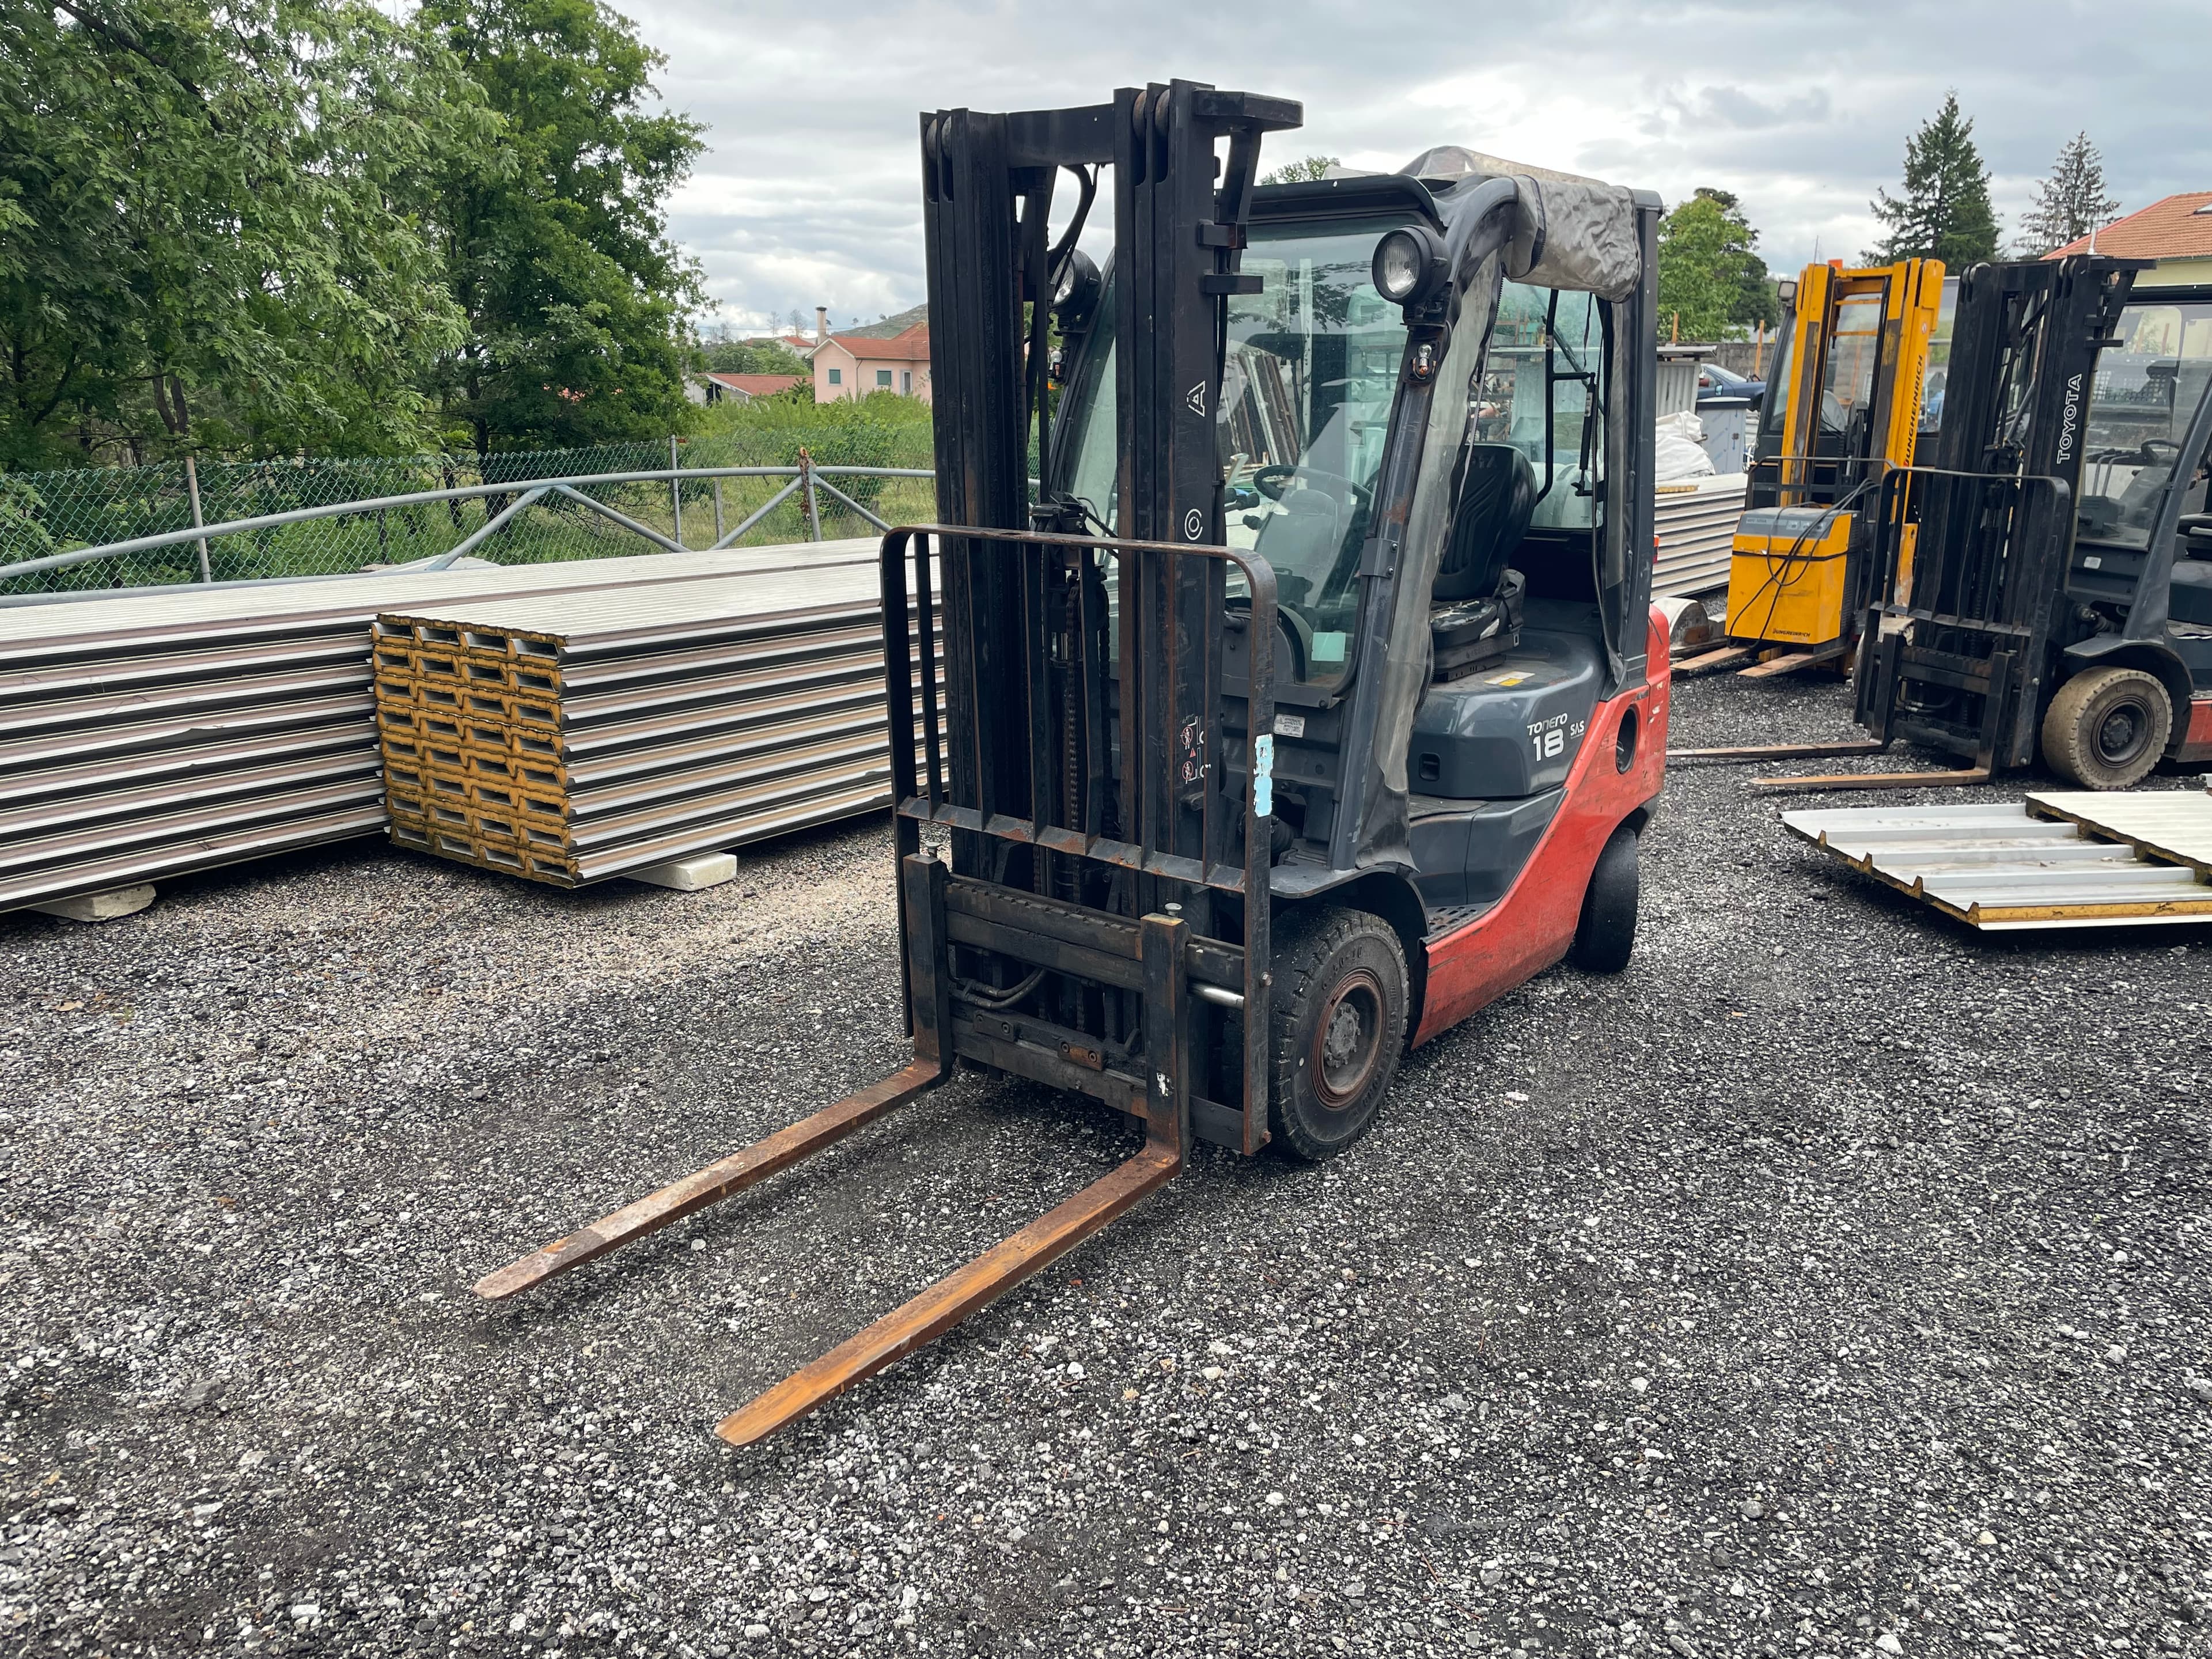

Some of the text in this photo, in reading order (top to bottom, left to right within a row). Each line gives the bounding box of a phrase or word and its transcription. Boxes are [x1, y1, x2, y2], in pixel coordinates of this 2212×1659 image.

[1903, 354, 1923, 467] JUNGHEINRICH
[2056, 373, 2082, 464] TOYOTA
[1533, 728, 1565, 762] 18
[1570, 720, 1585, 736] SAS
